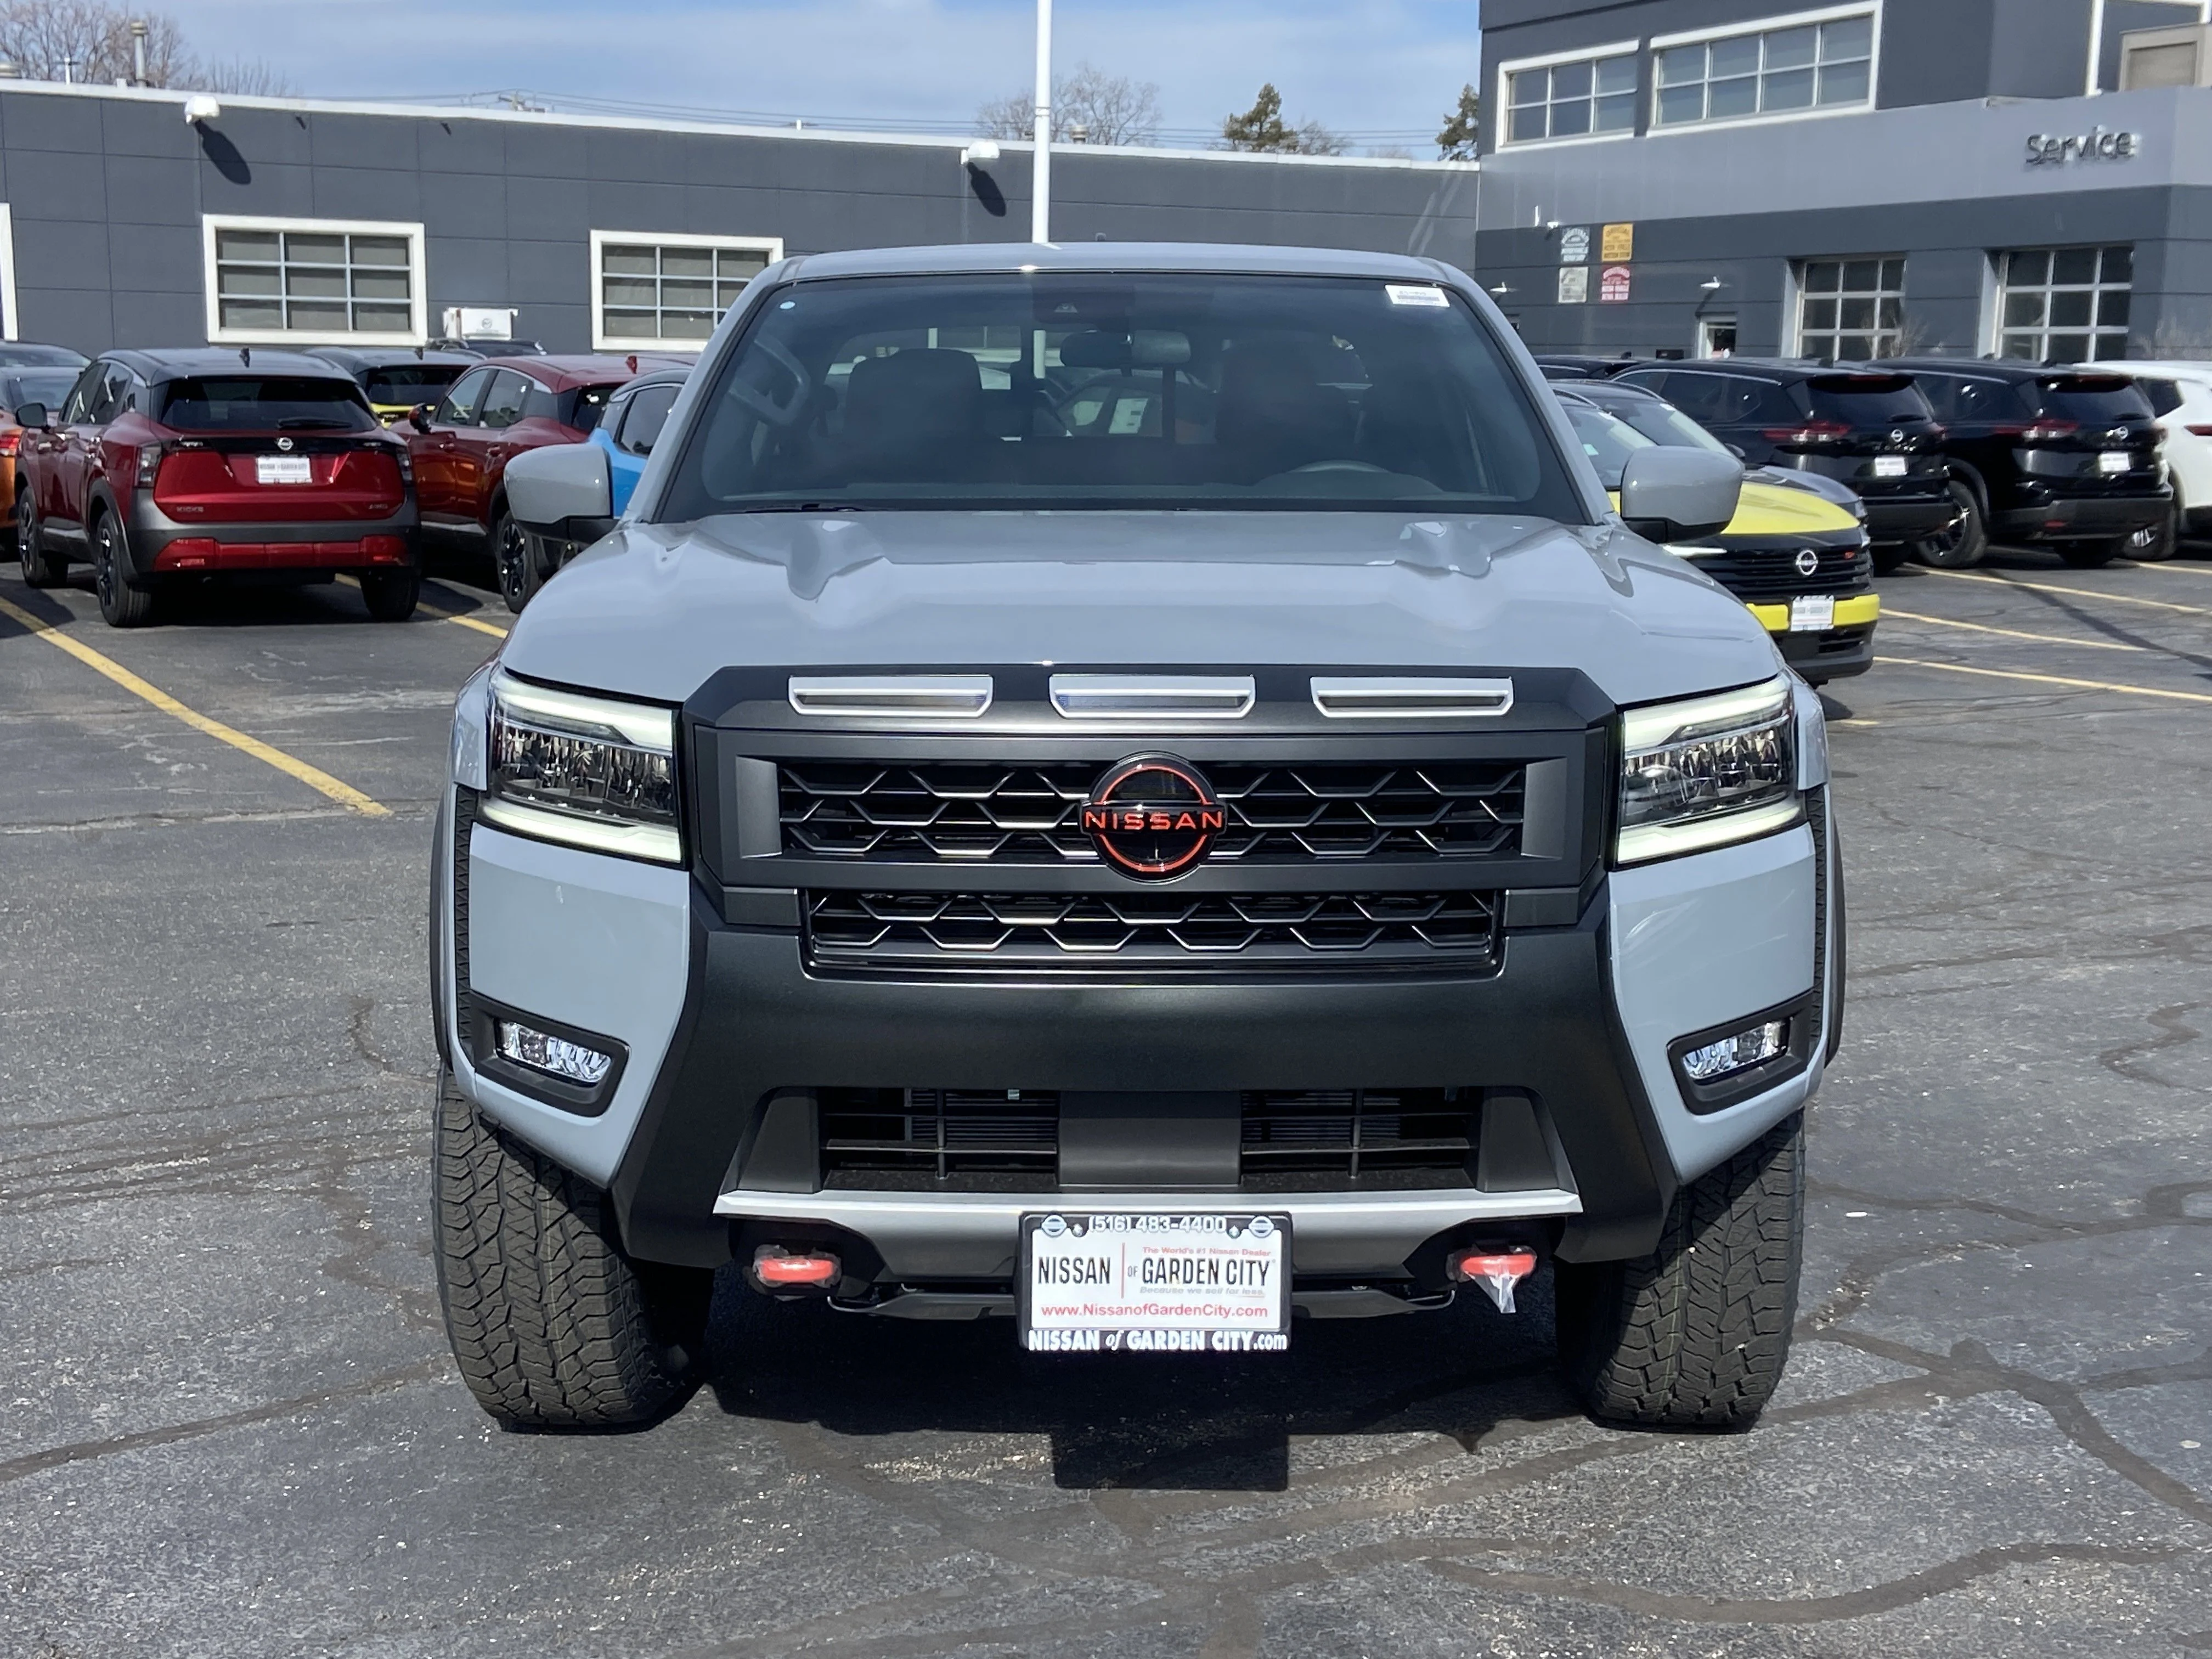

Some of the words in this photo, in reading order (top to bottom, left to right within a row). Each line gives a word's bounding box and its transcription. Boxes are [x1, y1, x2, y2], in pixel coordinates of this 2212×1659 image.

[2025, 125, 2140, 165] Service
[1085, 810, 1223, 830] NISSAN
[1088, 1215, 1131, 1233] (516)
[1135, 1215, 1227, 1233] 483-4400
[1038, 1256, 1110, 1284] NISSAN
[1127, 1265, 1138, 1277] OF
[1142, 1257, 1220, 1285] GARDEN
[1226, 1259, 1270, 1286] CITY
[1041, 1303, 1268, 1318] www.NissanofGardenCity.com
[1028, 1330, 1100, 1351] NISSAN
[1105, 1329, 1124, 1351] of
[1127, 1330, 1205, 1351] GARDEN
[1211, 1330, 1288, 1351] CITY.com
